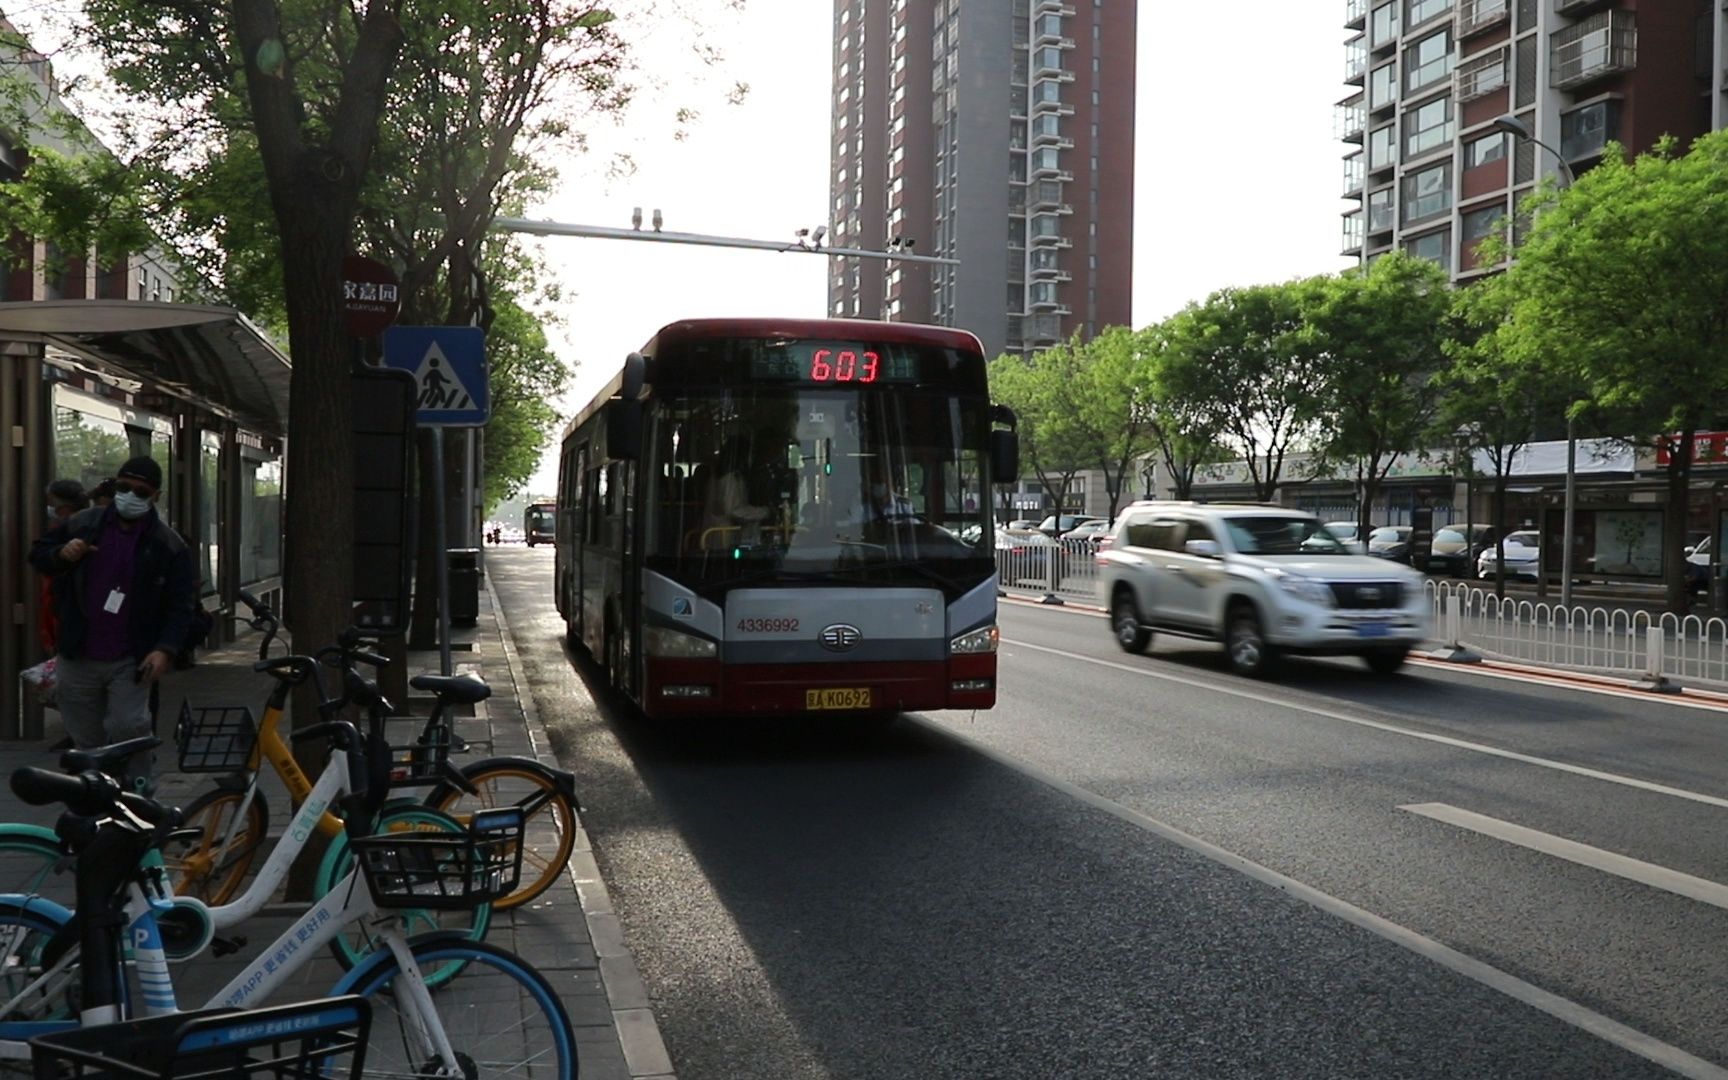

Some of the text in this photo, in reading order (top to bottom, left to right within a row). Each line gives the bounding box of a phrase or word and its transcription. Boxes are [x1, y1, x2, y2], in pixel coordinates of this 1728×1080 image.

[811, 348, 881, 384] 603
[737, 618, 799, 632] 4336992
[134, 928, 149, 949] P
